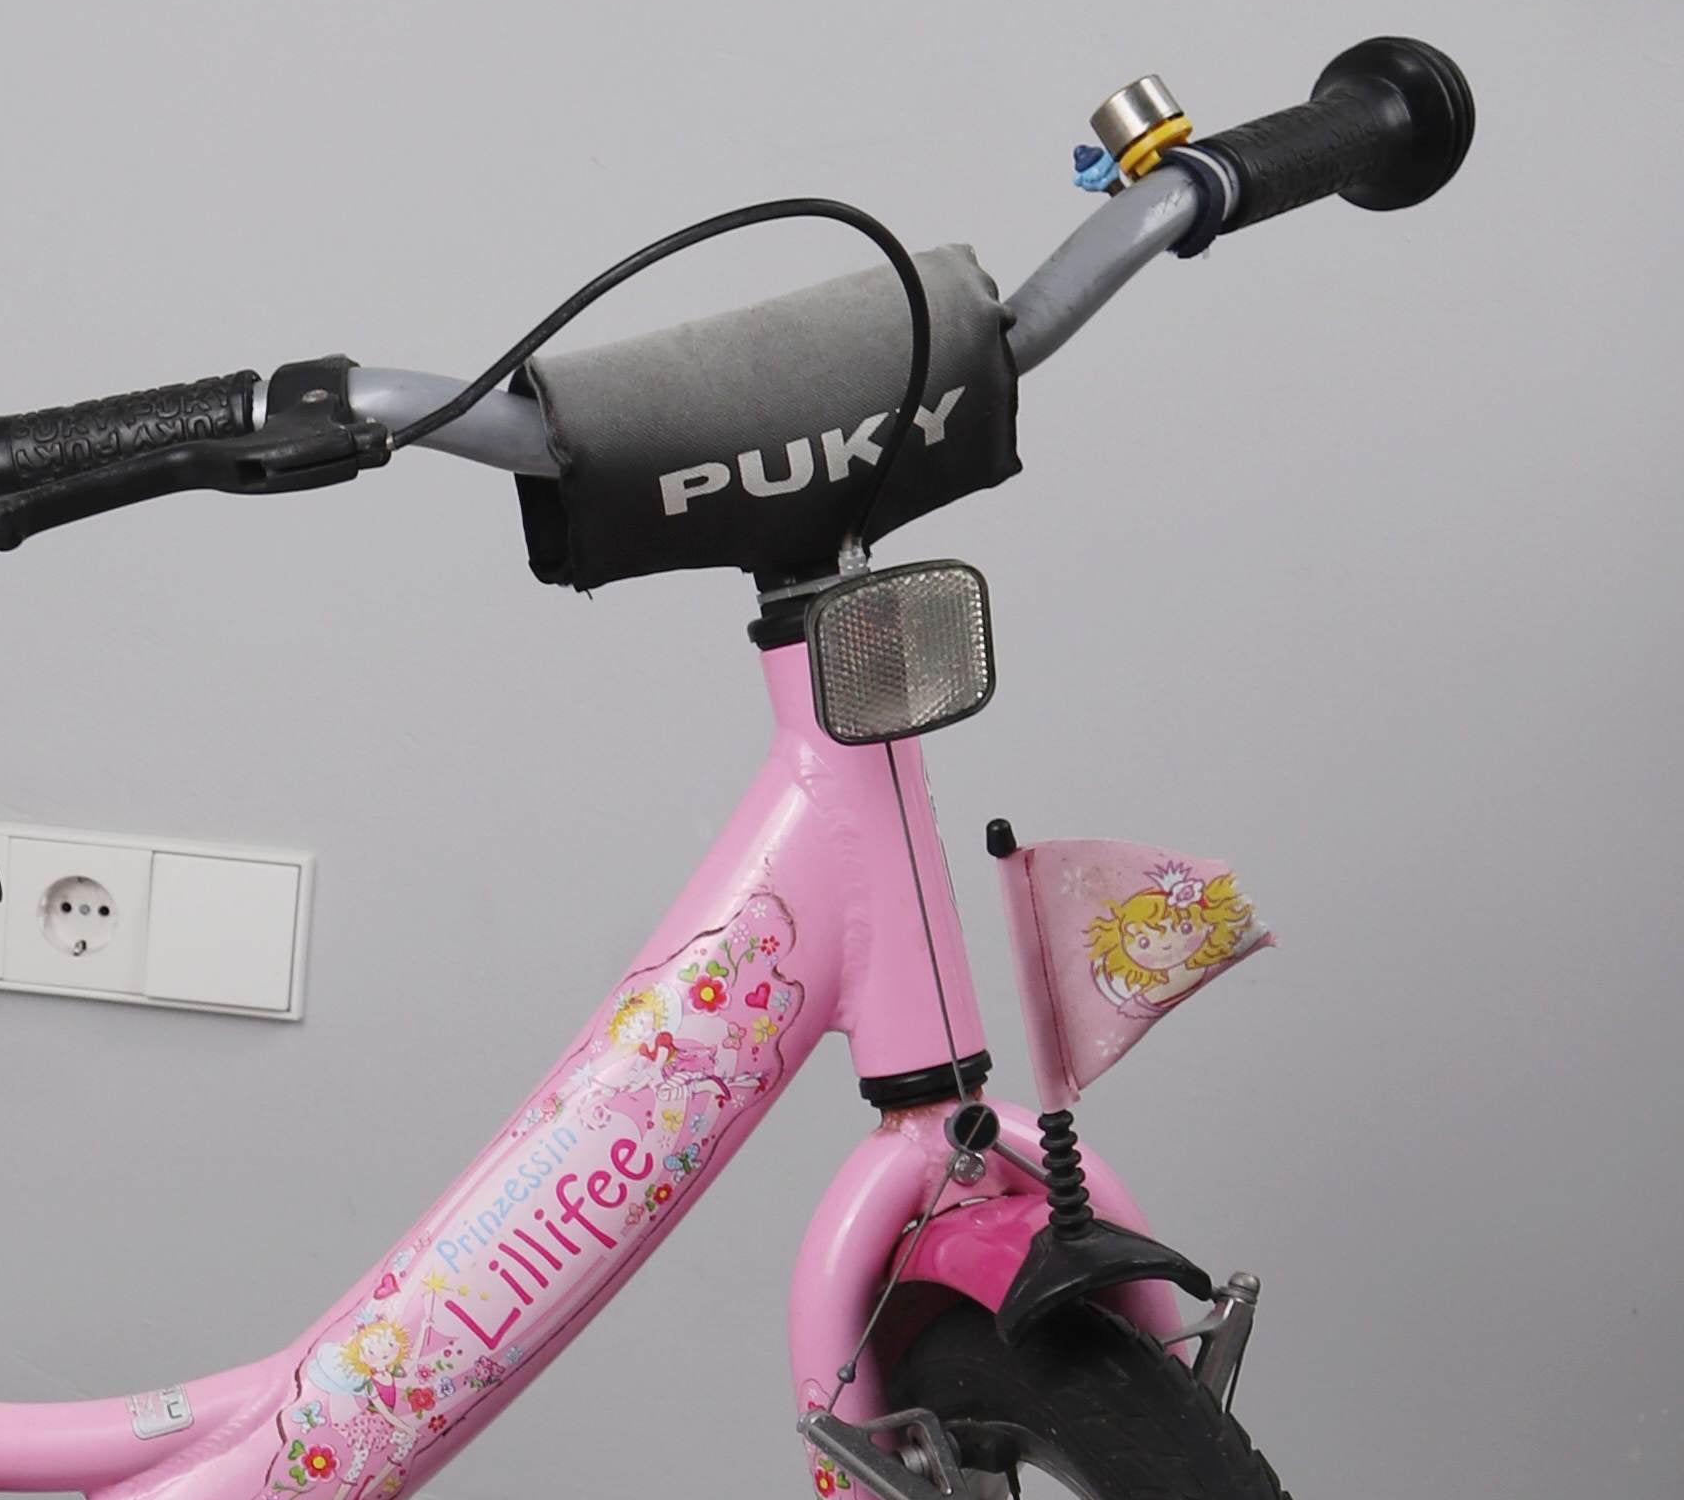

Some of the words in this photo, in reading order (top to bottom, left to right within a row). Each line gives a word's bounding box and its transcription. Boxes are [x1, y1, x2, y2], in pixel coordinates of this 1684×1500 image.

[659, 385, 966, 516] PUKY
[435, 1126, 579, 1274] Prinzessin
[444, 1138, 654, 1350] Lillifee
